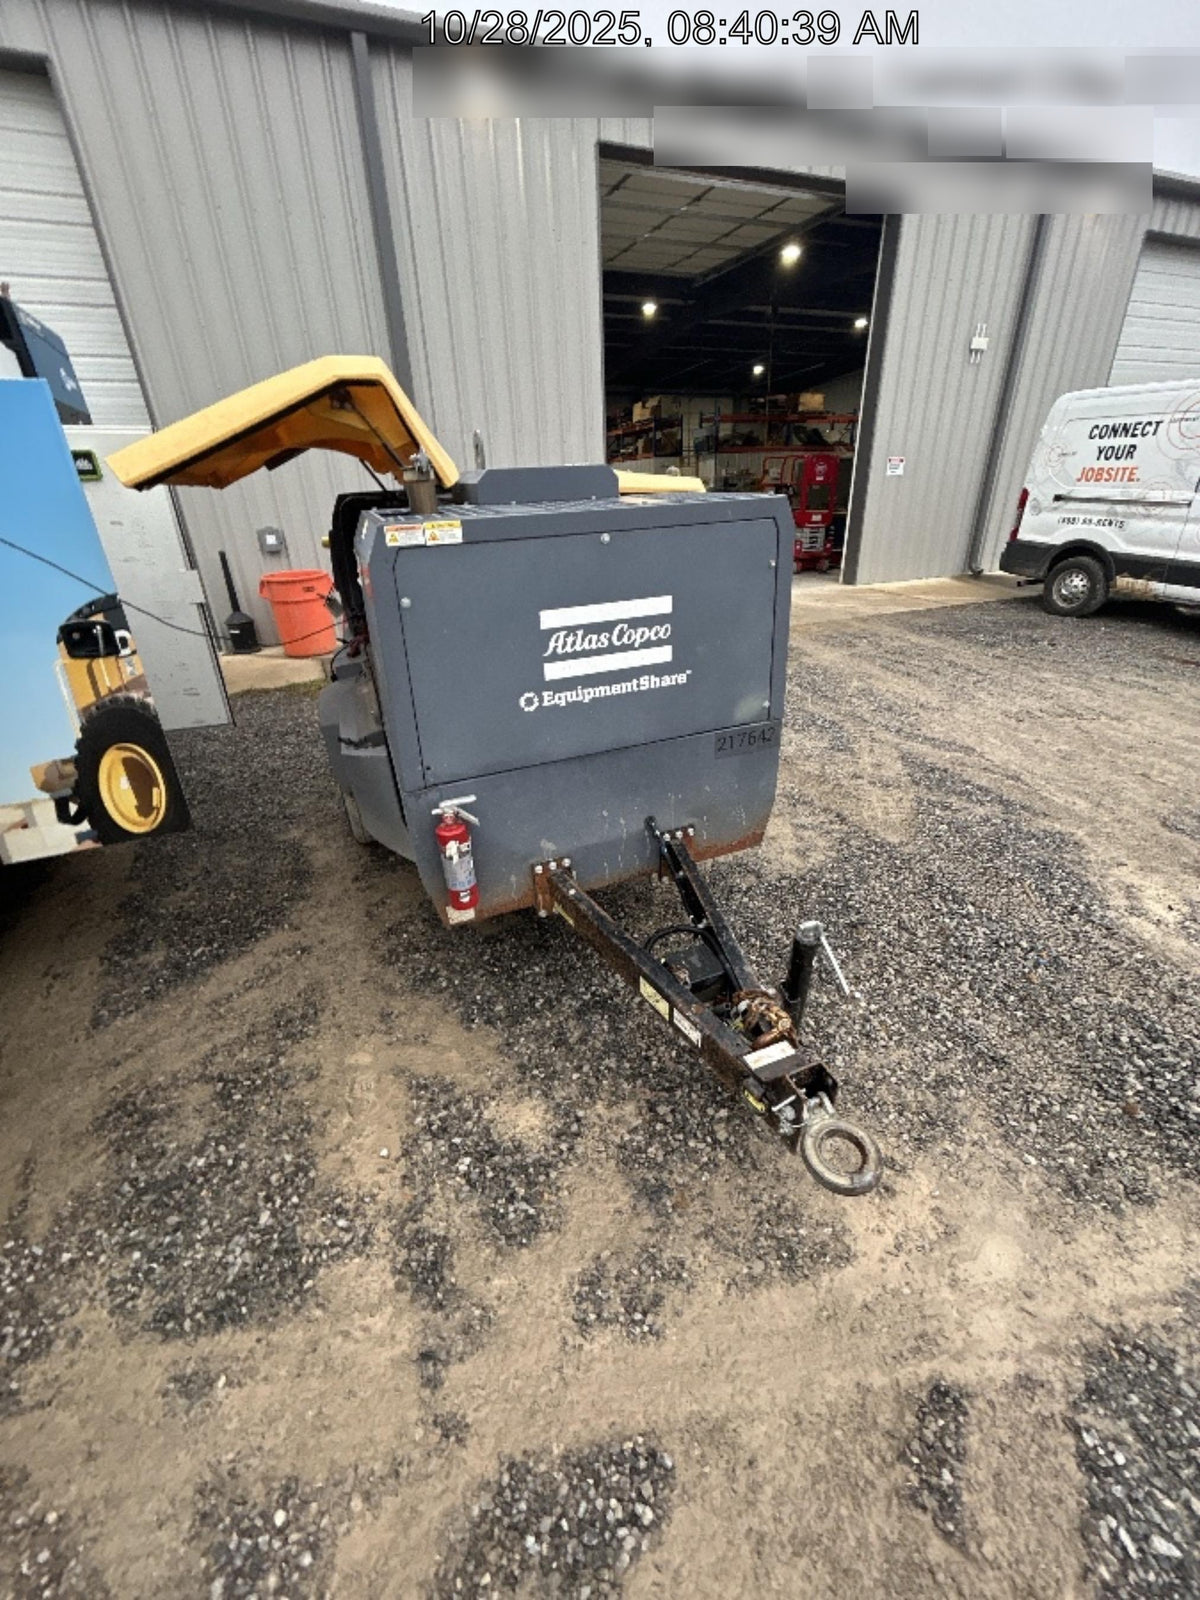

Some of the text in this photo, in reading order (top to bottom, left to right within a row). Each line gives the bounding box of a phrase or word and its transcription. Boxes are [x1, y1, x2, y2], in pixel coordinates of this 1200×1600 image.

[1088, 420, 1163, 440] CONNECT
[1096, 444, 1137, 461] YOUR
[1076, 466, 1141, 482] JOBSITE.
[542, 623, 671, 657] Atlas Copco
[717, 726, 776, 752] 217642
